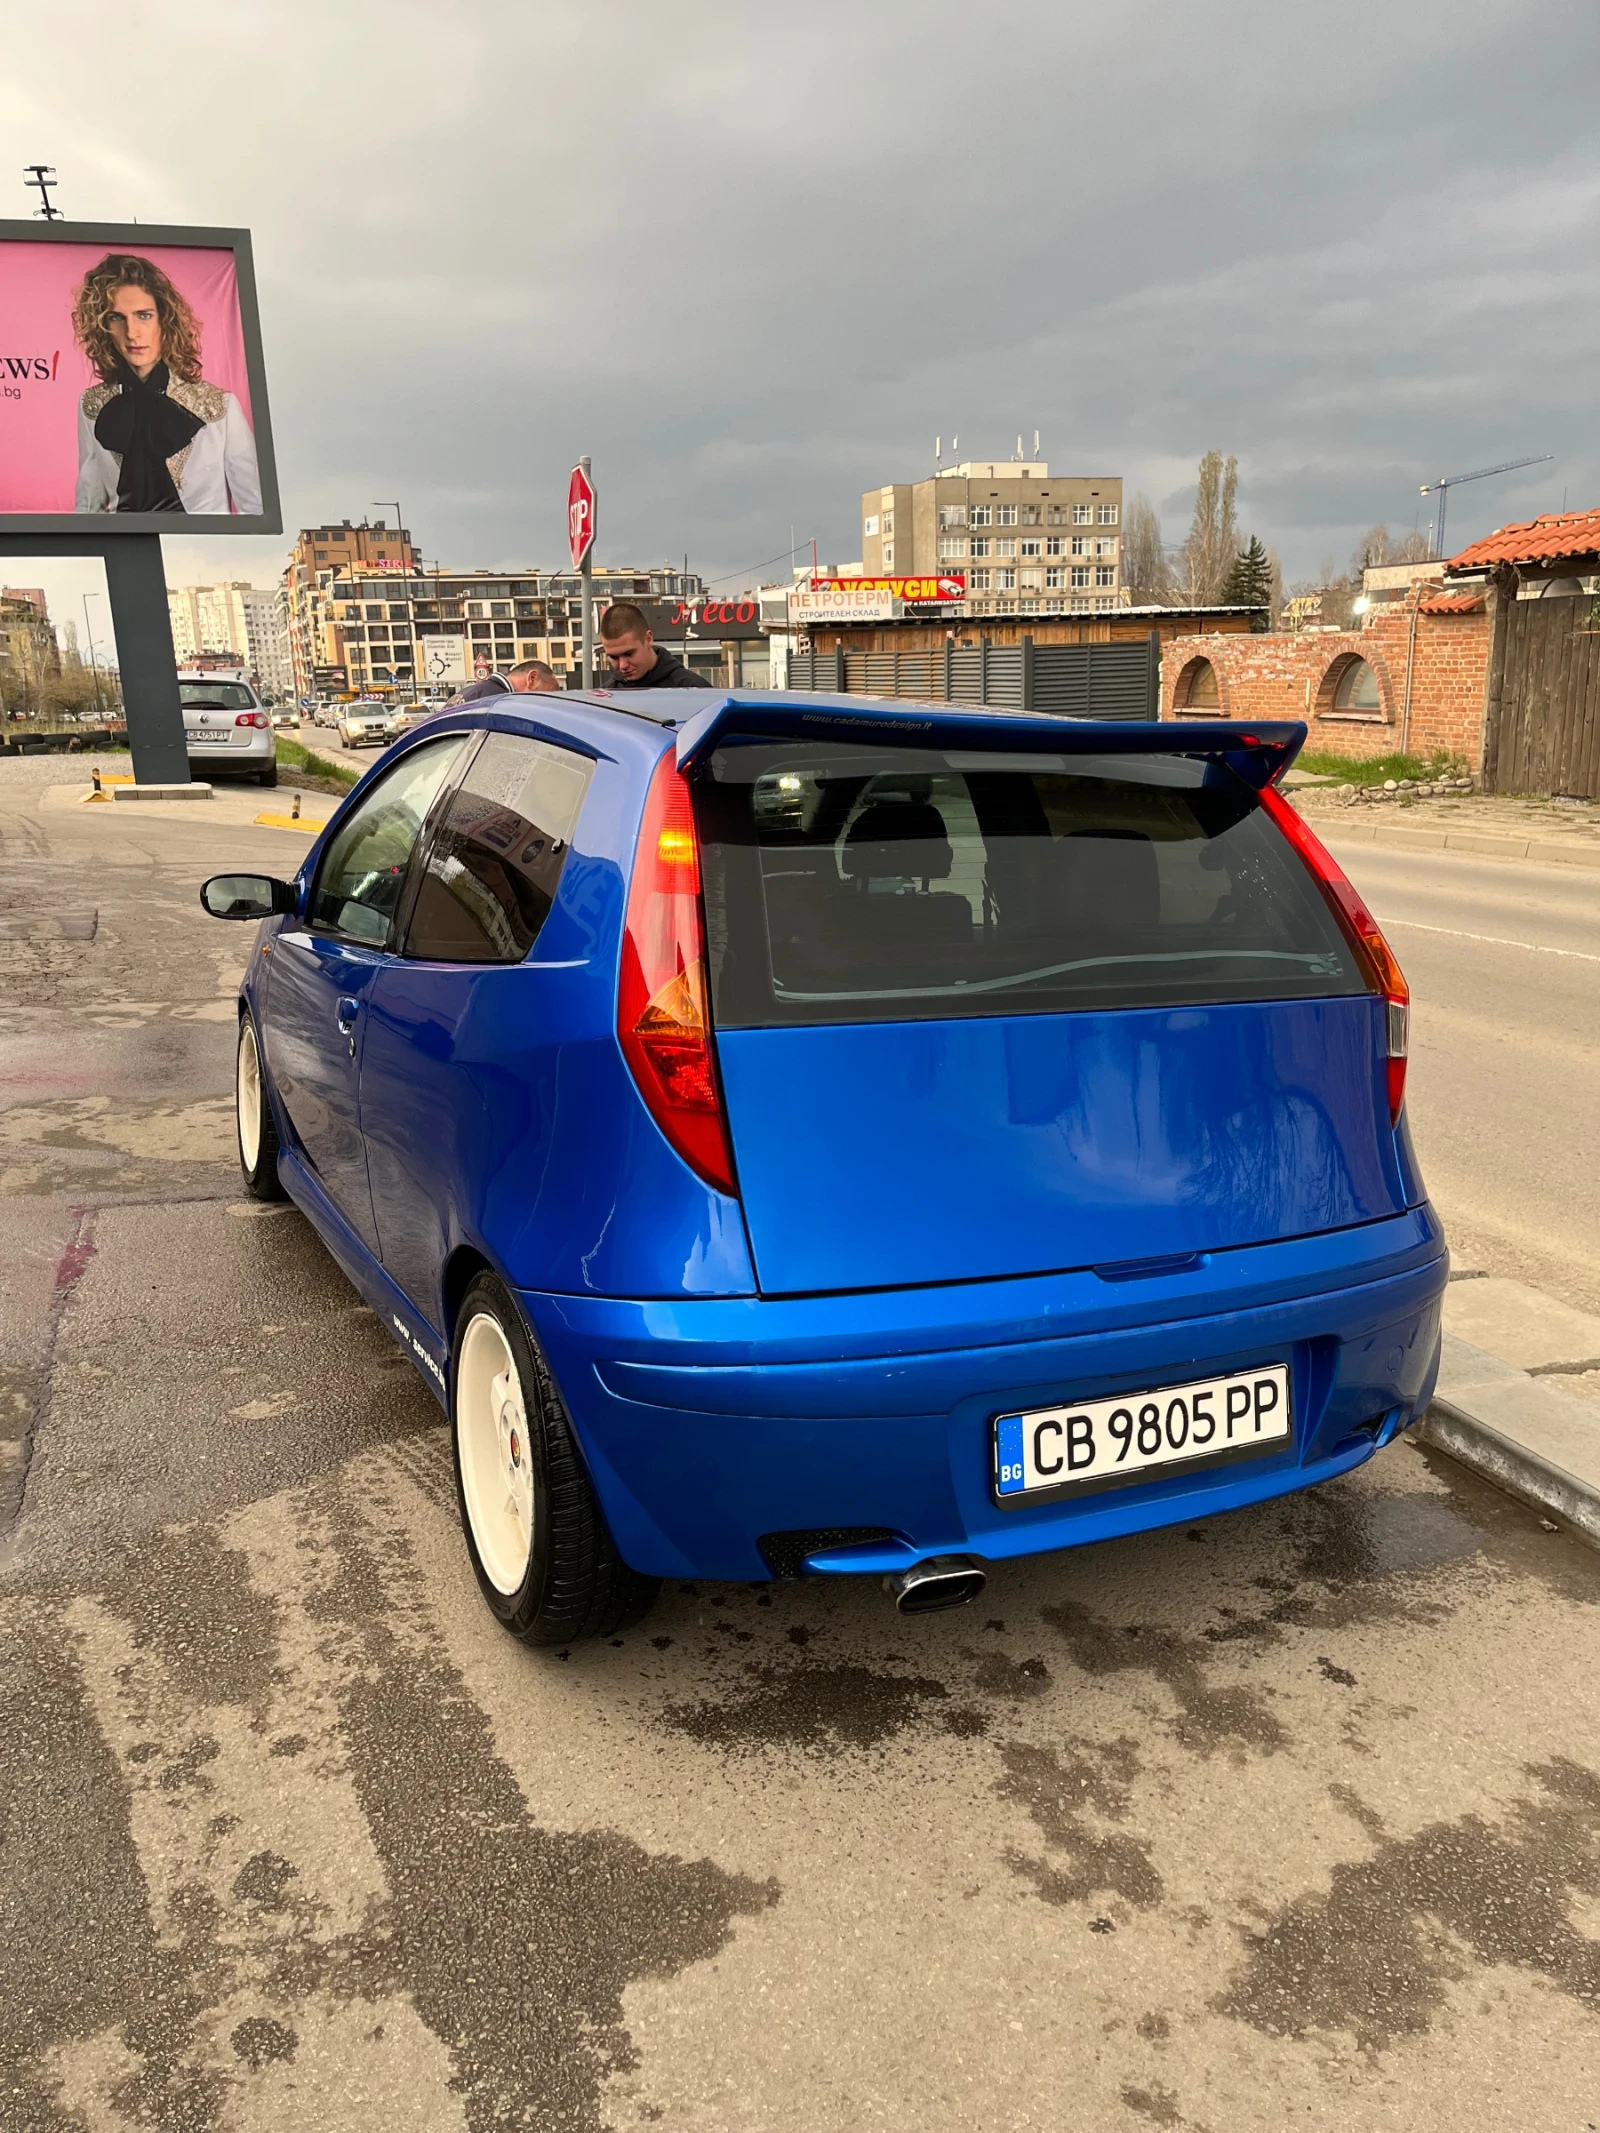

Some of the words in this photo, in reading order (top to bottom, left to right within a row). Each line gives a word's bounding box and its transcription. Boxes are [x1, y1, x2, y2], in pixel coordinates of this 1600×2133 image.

[570, 499, 588, 538] STOP
[789, 592, 889, 607] ПЕТРОТЕРМ
[798, 610, 851, 619] СТРОИТЕЛЕН
[852, 609, 880, 617] СКЛАД
[478, 669, 485, 677] 40
[1034, 1415, 1096, 1475] CB
[1108, 1391, 1216, 1462] 9805
[1226, 1379, 1278, 1438] PP
[1001, 1463, 1022, 1482] BG
